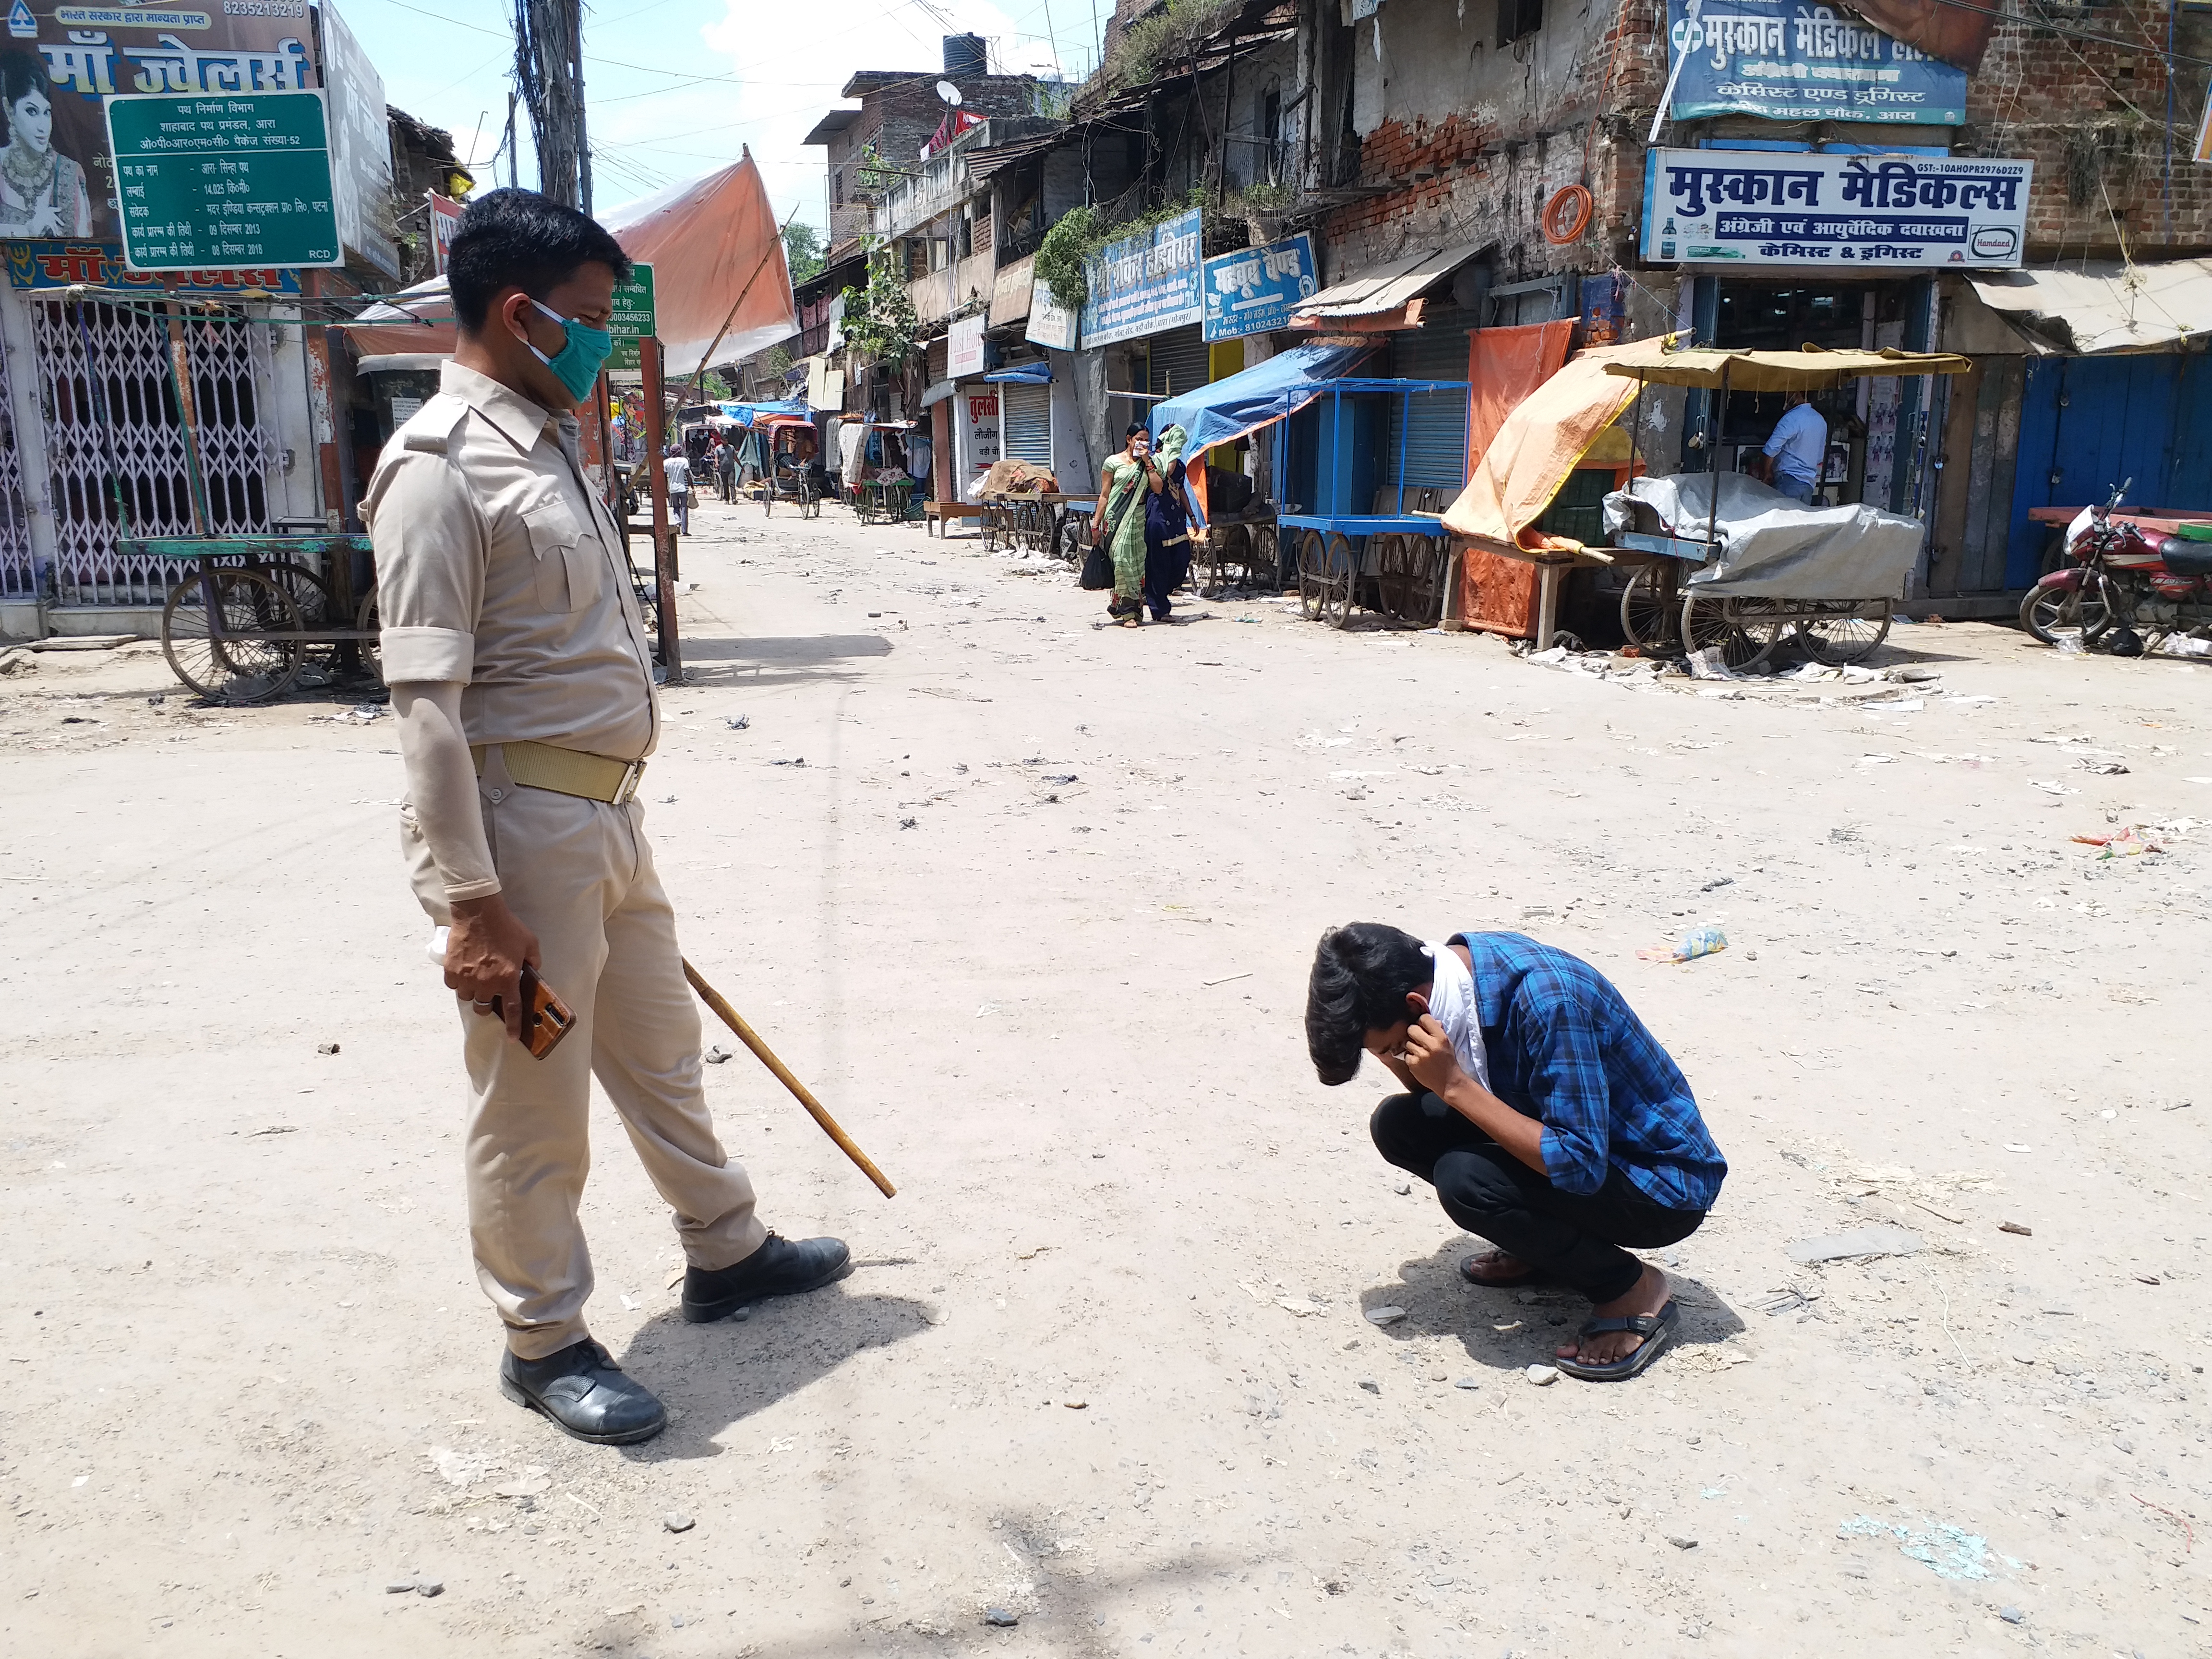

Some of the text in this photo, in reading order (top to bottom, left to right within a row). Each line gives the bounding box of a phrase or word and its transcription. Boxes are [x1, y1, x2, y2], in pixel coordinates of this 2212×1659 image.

[60, 9, 205, 26] भारत सरकार द्वारा मान्यता प्राप्त
[223, 1, 304, 18] 8235213219
[1702, 15, 1787, 70] मुस्कान
[1793, 6, 1881, 60] मेडिकल
[38, 30, 115, 94] माँ
[1716, 81, 1926, 105] केमिस्ट एण्ड ड्रगिस्ट
[177, 101, 254, 115] पथ निर्माण विभाग
[1772, 107, 1822, 117] महल
[1877, 111, 1917, 120] आरा
[159, 120, 196, 132] शाहाबाद
[200, 120, 215, 131] पथ
[255, 119, 276, 129] आरा
[234, 134, 258, 146] पैकेज
[122, 166, 133, 177] पथ
[135, 165, 145, 176] का
[146, 164, 158, 176] नाम
[239, 162, 249, 173] पथ
[125, 181, 145, 199] लम्बाई
[204, 183, 225, 195] 14.025
[1665, 161, 2023, 216] मुस्कान मेडिकल्स
[128, 202, 149, 217] संवेदक
[205, 204, 220, 215] मदर
[222, 199, 243, 216] इण्डिया
[312, 200, 328, 213] पटना
[131, 222, 145, 238] कार्य
[166, 221, 176, 237] की
[177, 220, 192, 237] तिथी
[209, 224, 217, 236] 09
[219, 220, 242, 235] दिसम्बर
[245, 223, 260, 234] 2013
[1719, 216, 1776, 234] अंग्रेजी
[1779, 218, 1808, 234] एवं
[1812, 219, 1895, 240] आयुर्वेदिक
[133, 242, 148, 258] कार्य
[169, 241, 179, 257] की
[180, 241, 195, 257] तिथी
[212, 244, 220, 256] 08
[222, 240, 245, 256] दिसम्बर
[247, 243, 263, 255] 2018
[1757, 242, 1924, 261] केमिस्ट & ड्रगिस्ट
[1977, 239, 2011, 247] Hamdard
[309, 249, 331, 259] RCD
[36, 246, 107, 283] माँ
[950, 332, 964, 354] Tulsi
[978, 446, 990, 457] बड़ी
